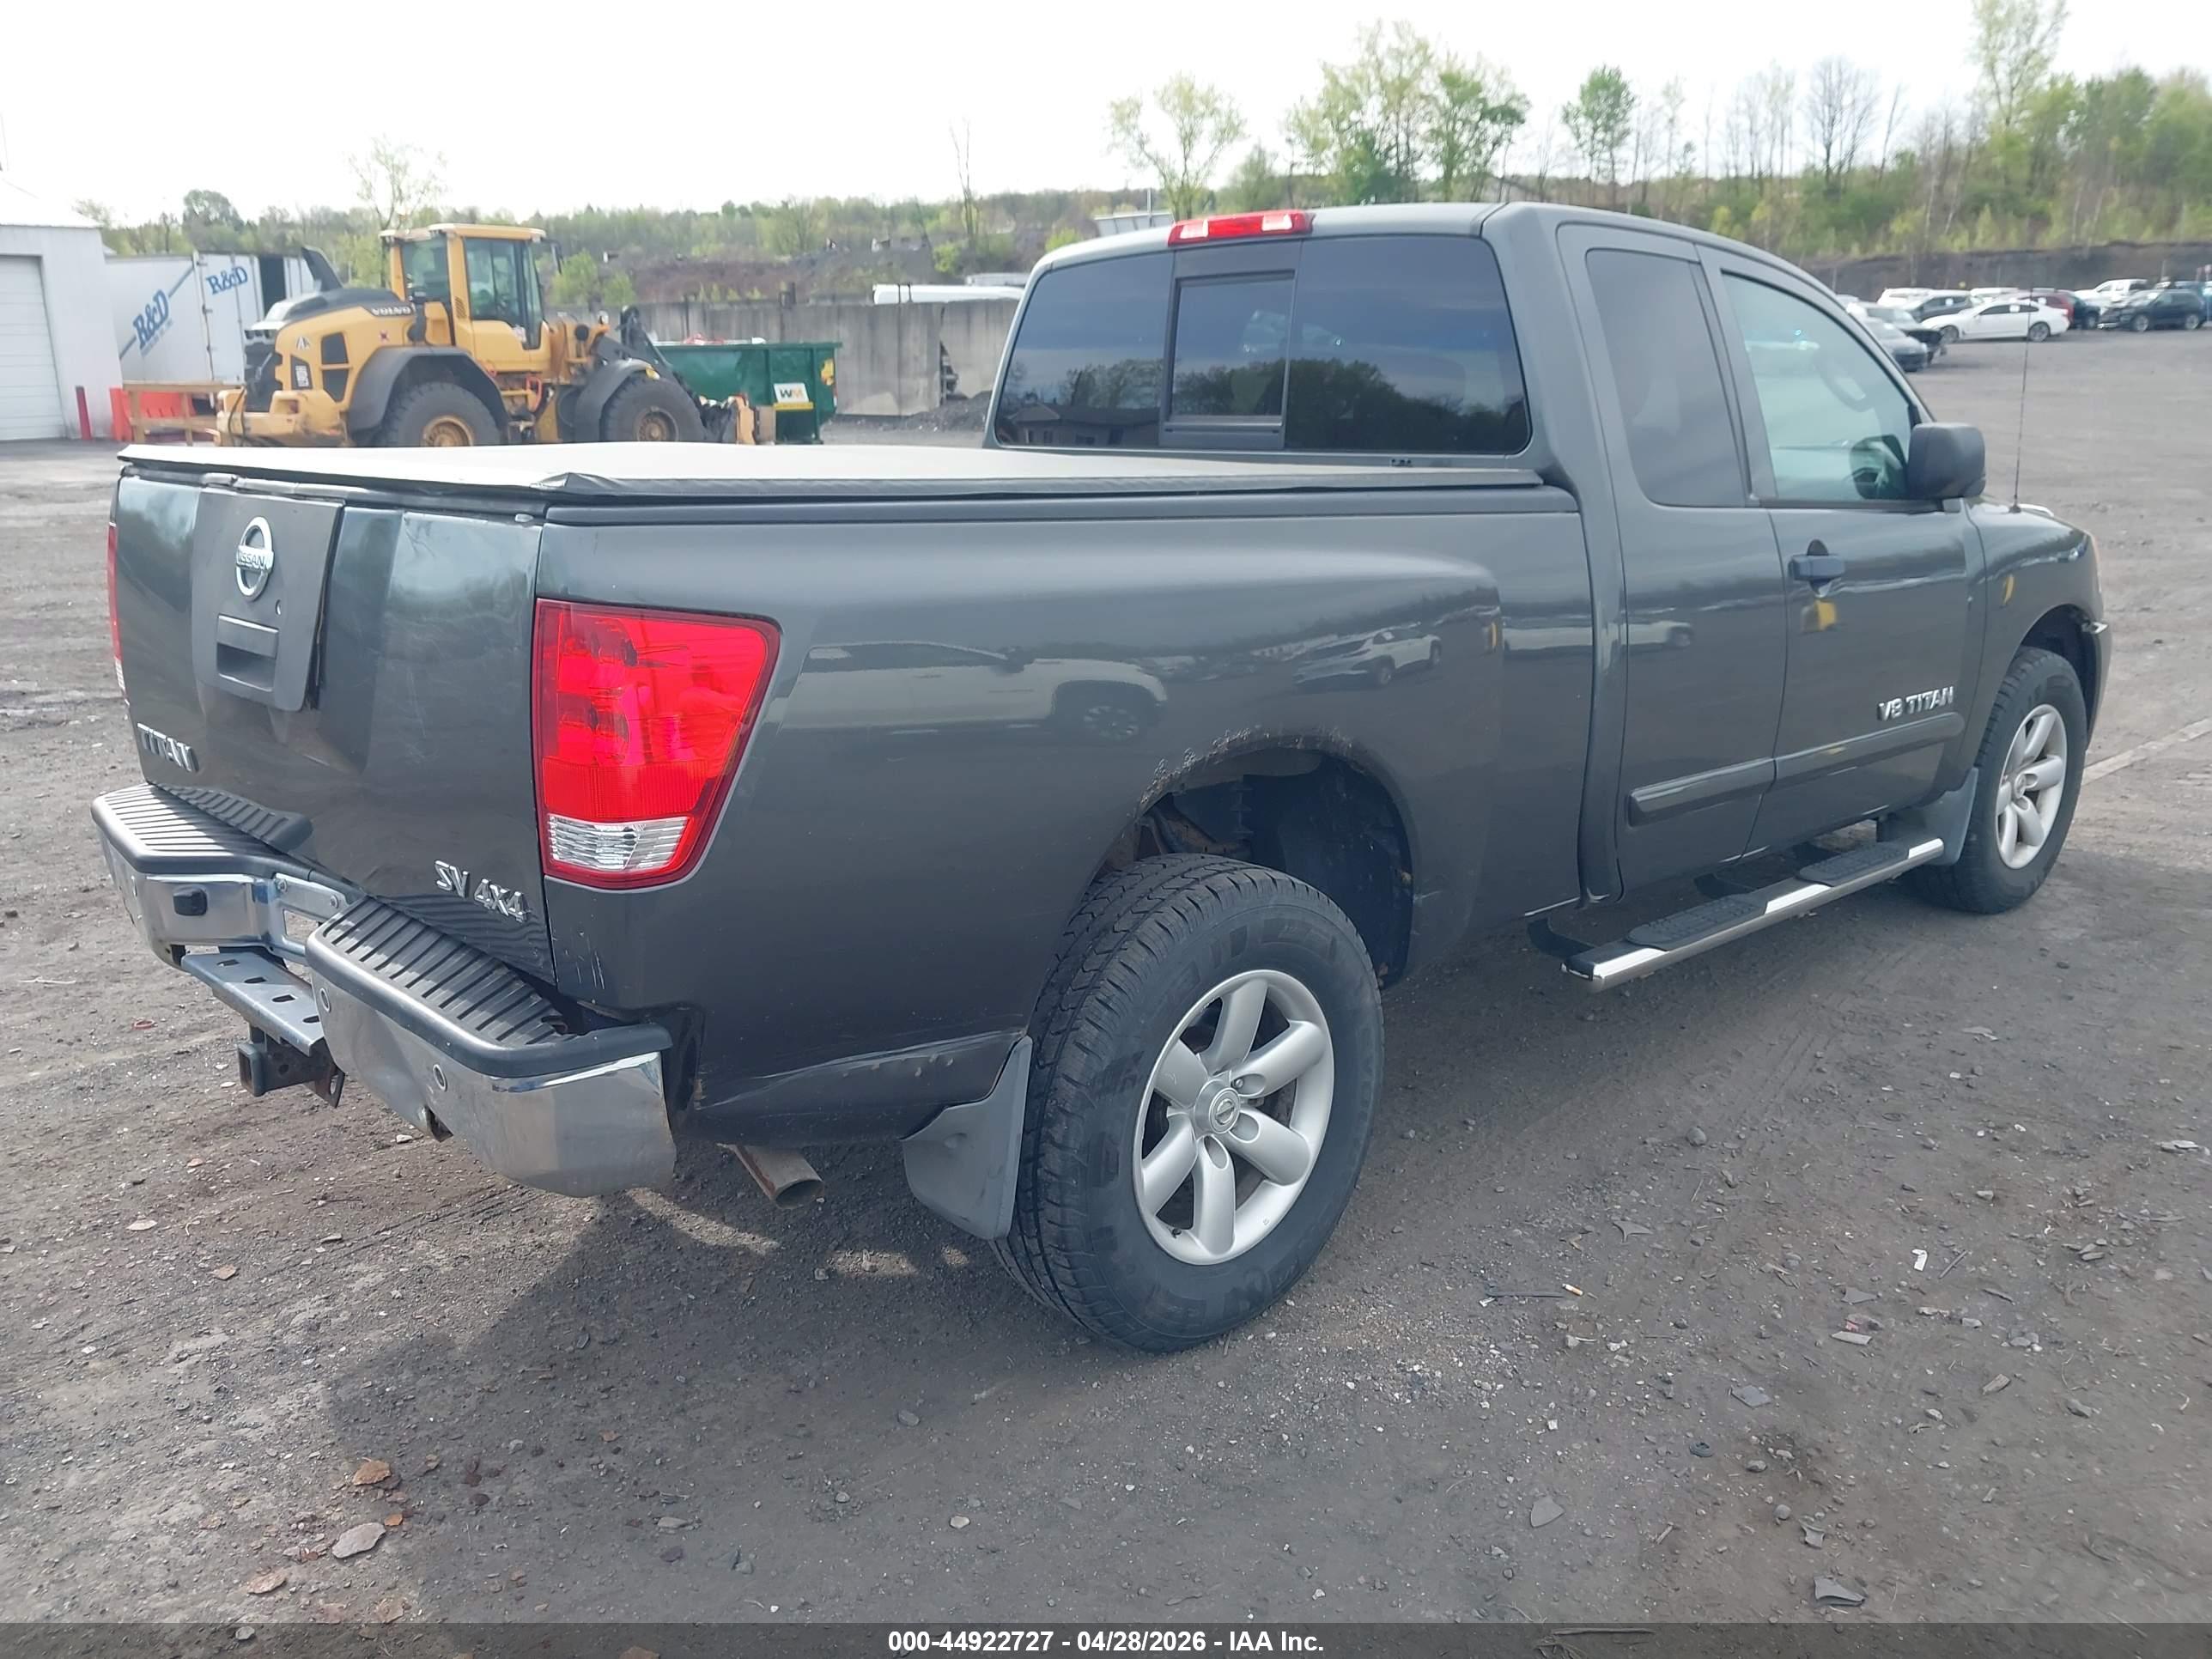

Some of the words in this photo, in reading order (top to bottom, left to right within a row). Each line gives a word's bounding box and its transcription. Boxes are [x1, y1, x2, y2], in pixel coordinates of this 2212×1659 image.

[206, 266, 248, 295] R&D
[133, 289, 169, 350] R&D
[371, 306, 412, 317] VOLVO
[1877, 697, 1903, 720] V8
[1905, 685, 1954, 714] TITAN
[137, 722, 194, 772] TITAN
[434, 860, 469, 898] SV
